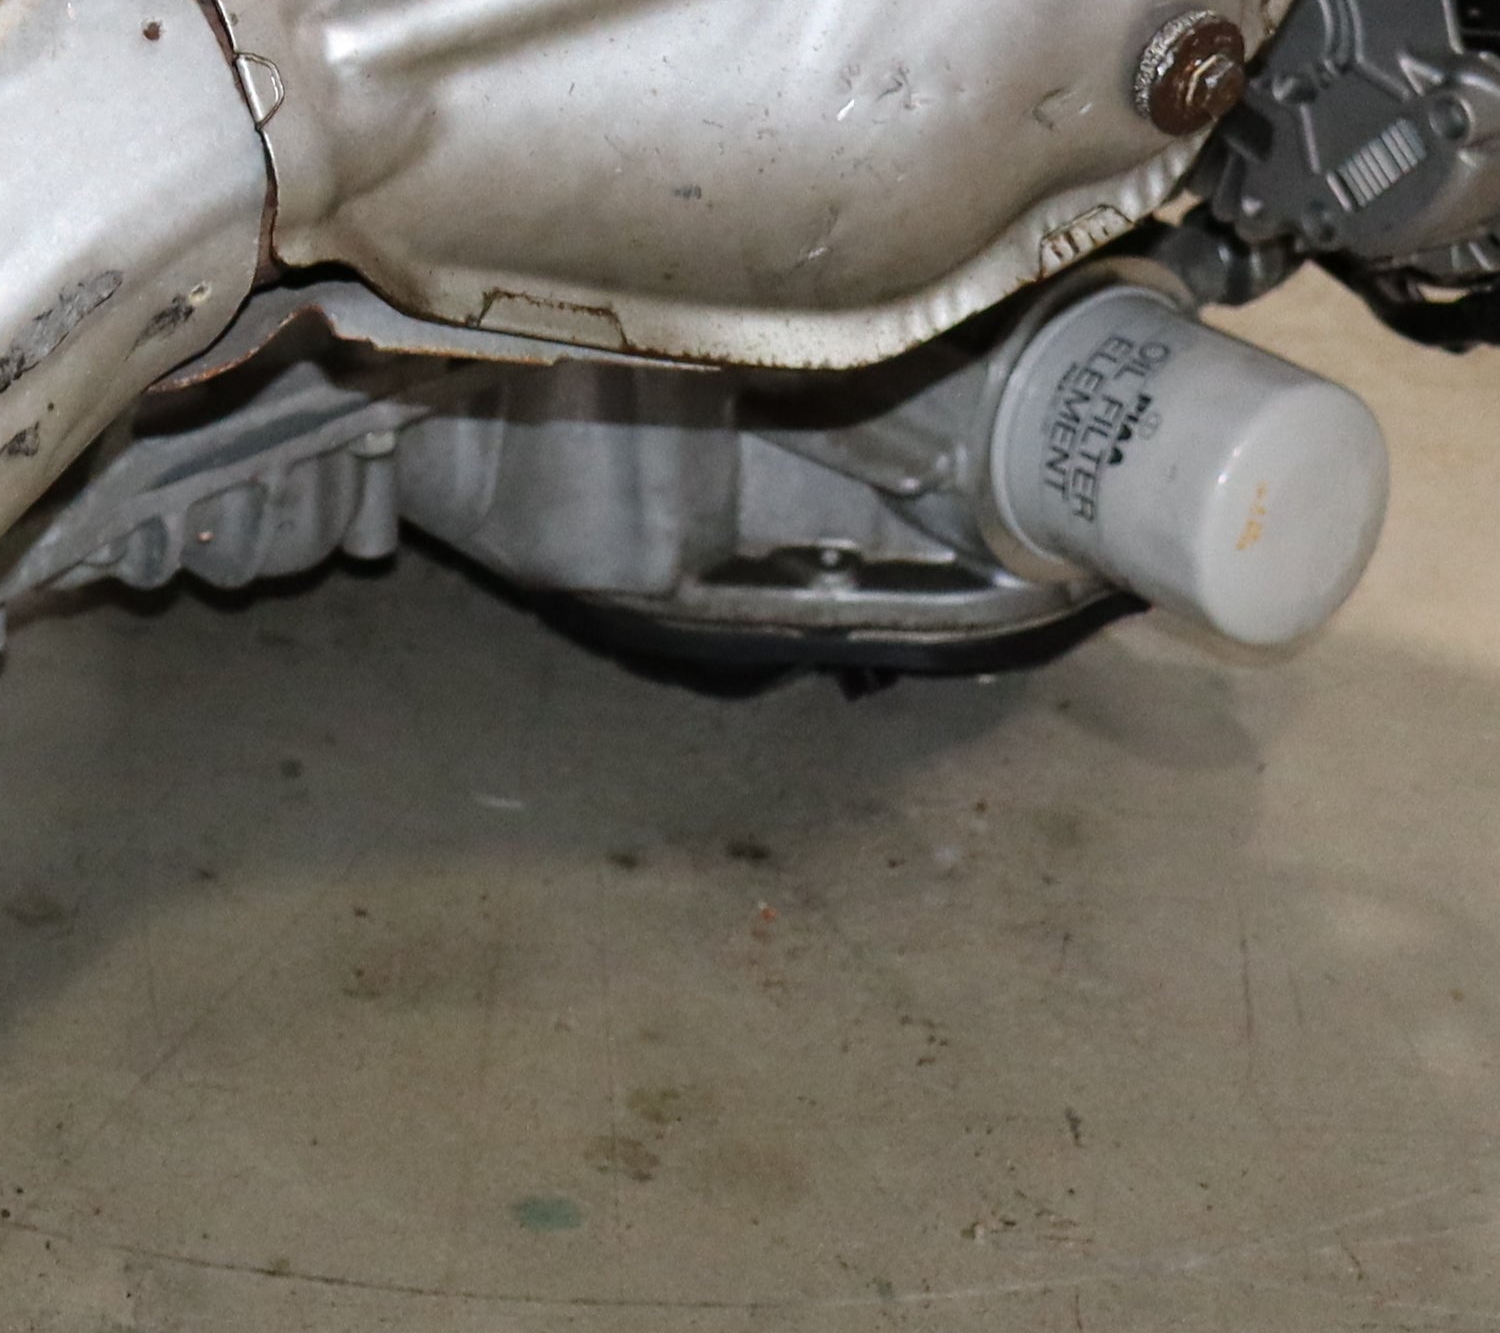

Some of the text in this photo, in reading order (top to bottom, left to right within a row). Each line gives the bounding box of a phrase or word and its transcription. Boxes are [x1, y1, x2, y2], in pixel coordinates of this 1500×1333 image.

[1044, 336, 1134, 500] ELEMENT
[1073, 341, 1171, 523] OIL FILTER
